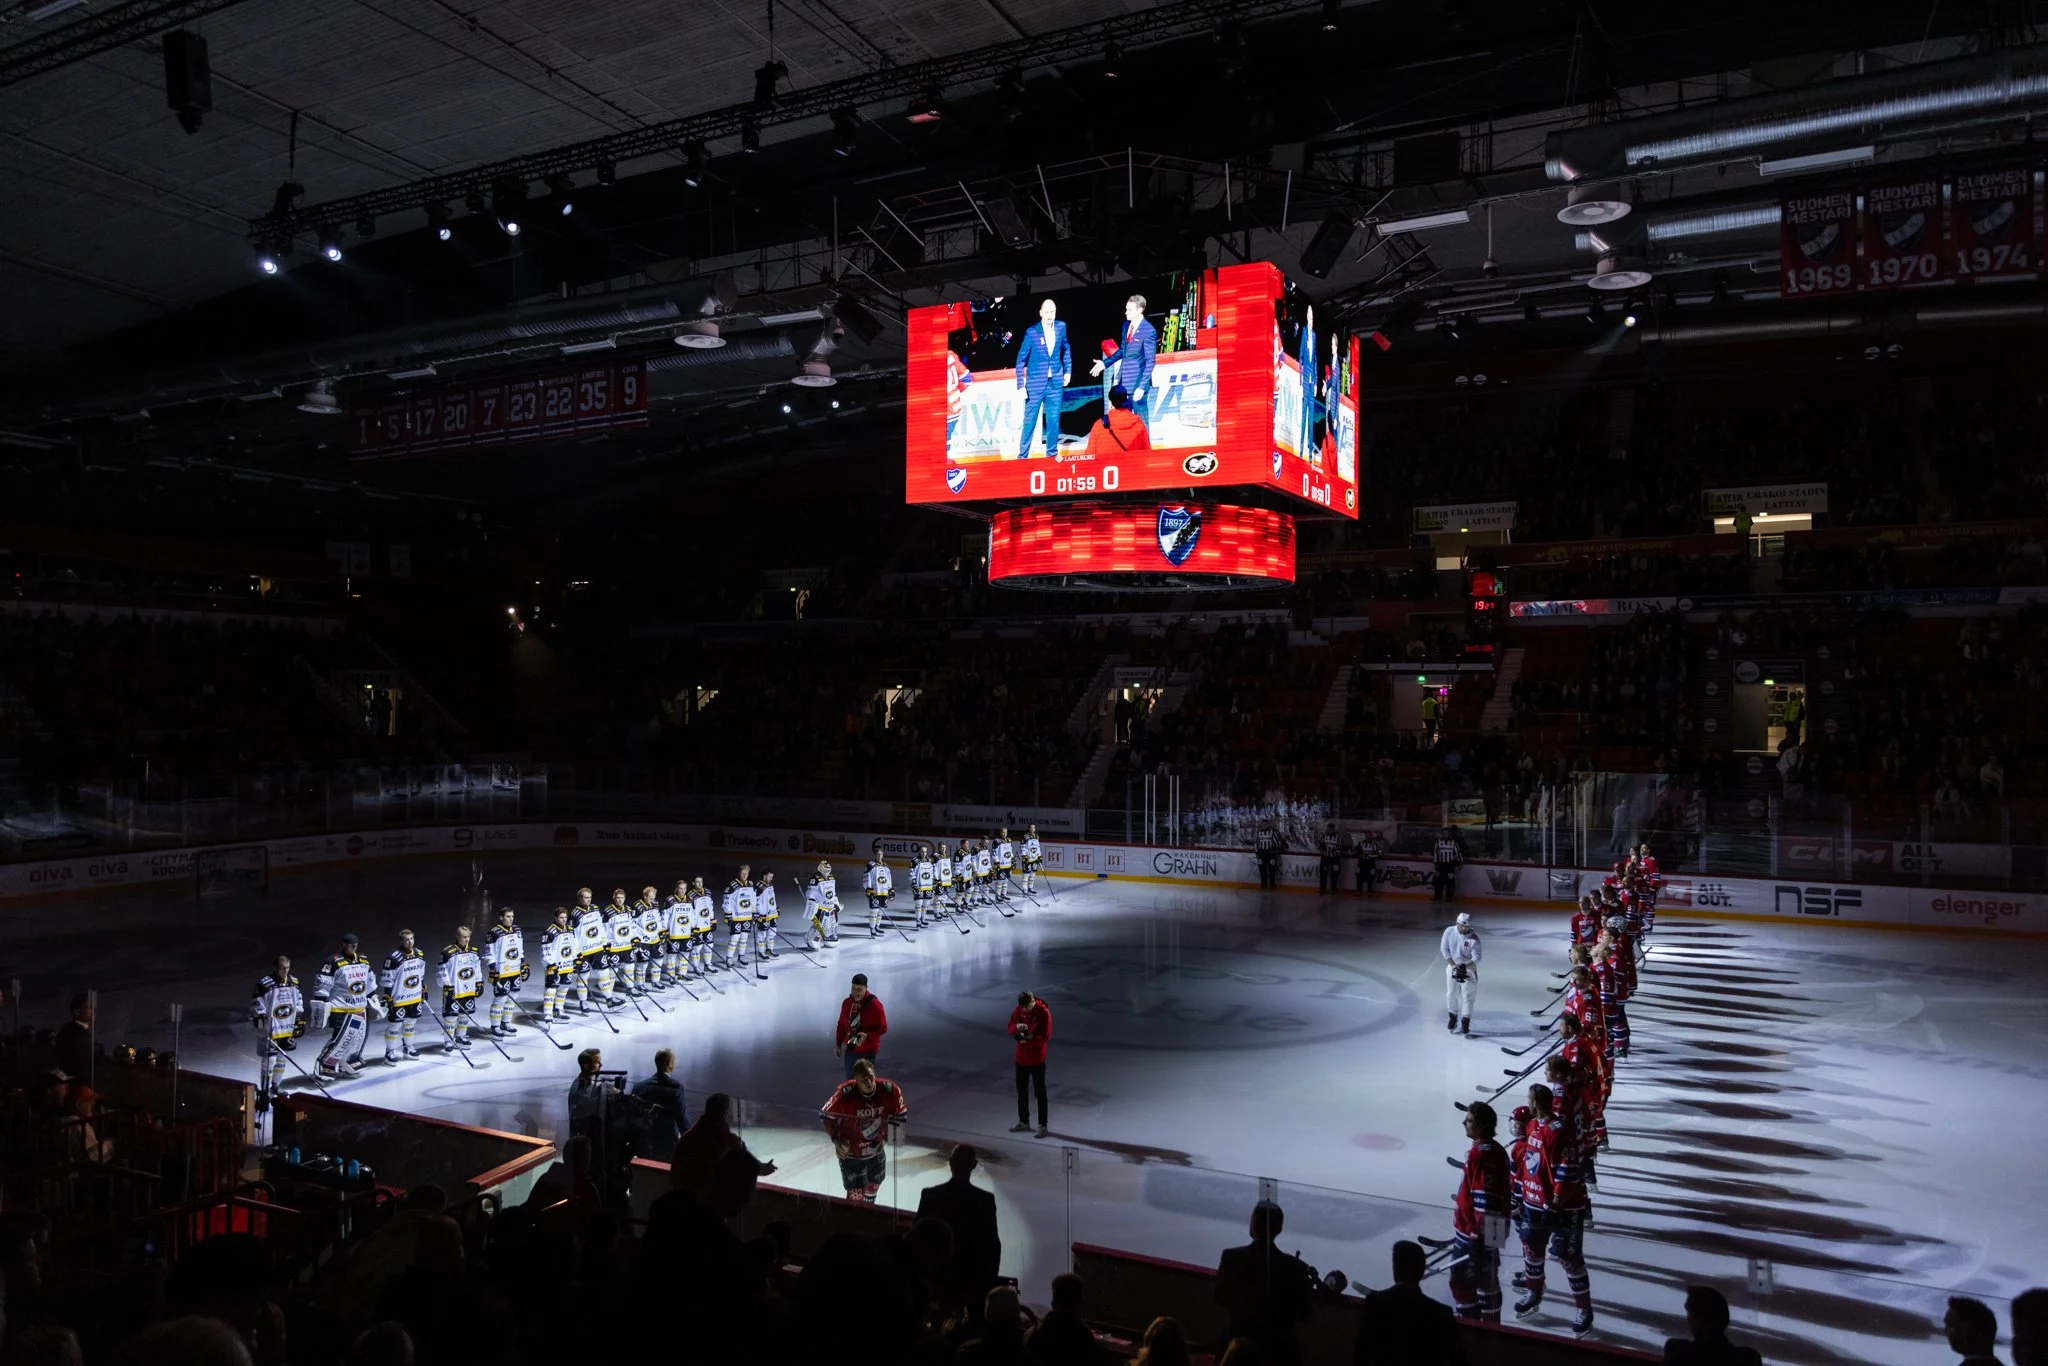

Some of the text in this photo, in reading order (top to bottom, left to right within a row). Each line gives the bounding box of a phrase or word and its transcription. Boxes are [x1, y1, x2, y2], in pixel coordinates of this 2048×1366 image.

[1957, 169, 2028, 189] SUOMEN
[1869, 181, 1937, 201] SUOMEN
[1957, 182, 2029, 201] MESTARI
[1786, 193, 1851, 213] SUOMEN
[1869, 194, 1937, 214] MESTARI
[1786, 206, 1851, 225] MESTARI
[1956, 243, 2028, 274] 1974
[1786, 263, 1852, 294] 1969
[1869, 253, 1938, 285] 1970
[359, 418, 368, 444] 1
[388, 414, 400, 440] 5
[415, 408, 436, 436] 17
[443, 403, 467, 432] 20
[483, 398, 496, 426] 7
[510, 392, 537, 422] 23
[545, 387, 572, 417] 22
[580, 380, 608, 411] 35
[624, 376, 637, 406] 9
[1070, 464, 1077, 474] 1
[1030, 465, 1119, 494] 0 01:59 0
[1164, 518, 1184, 528] 1897
[1153, 852, 1217, 876] GRAHN
[1173, 852, 1217, 861] RAKENNUS
[1931, 894, 2027, 925] elenger
